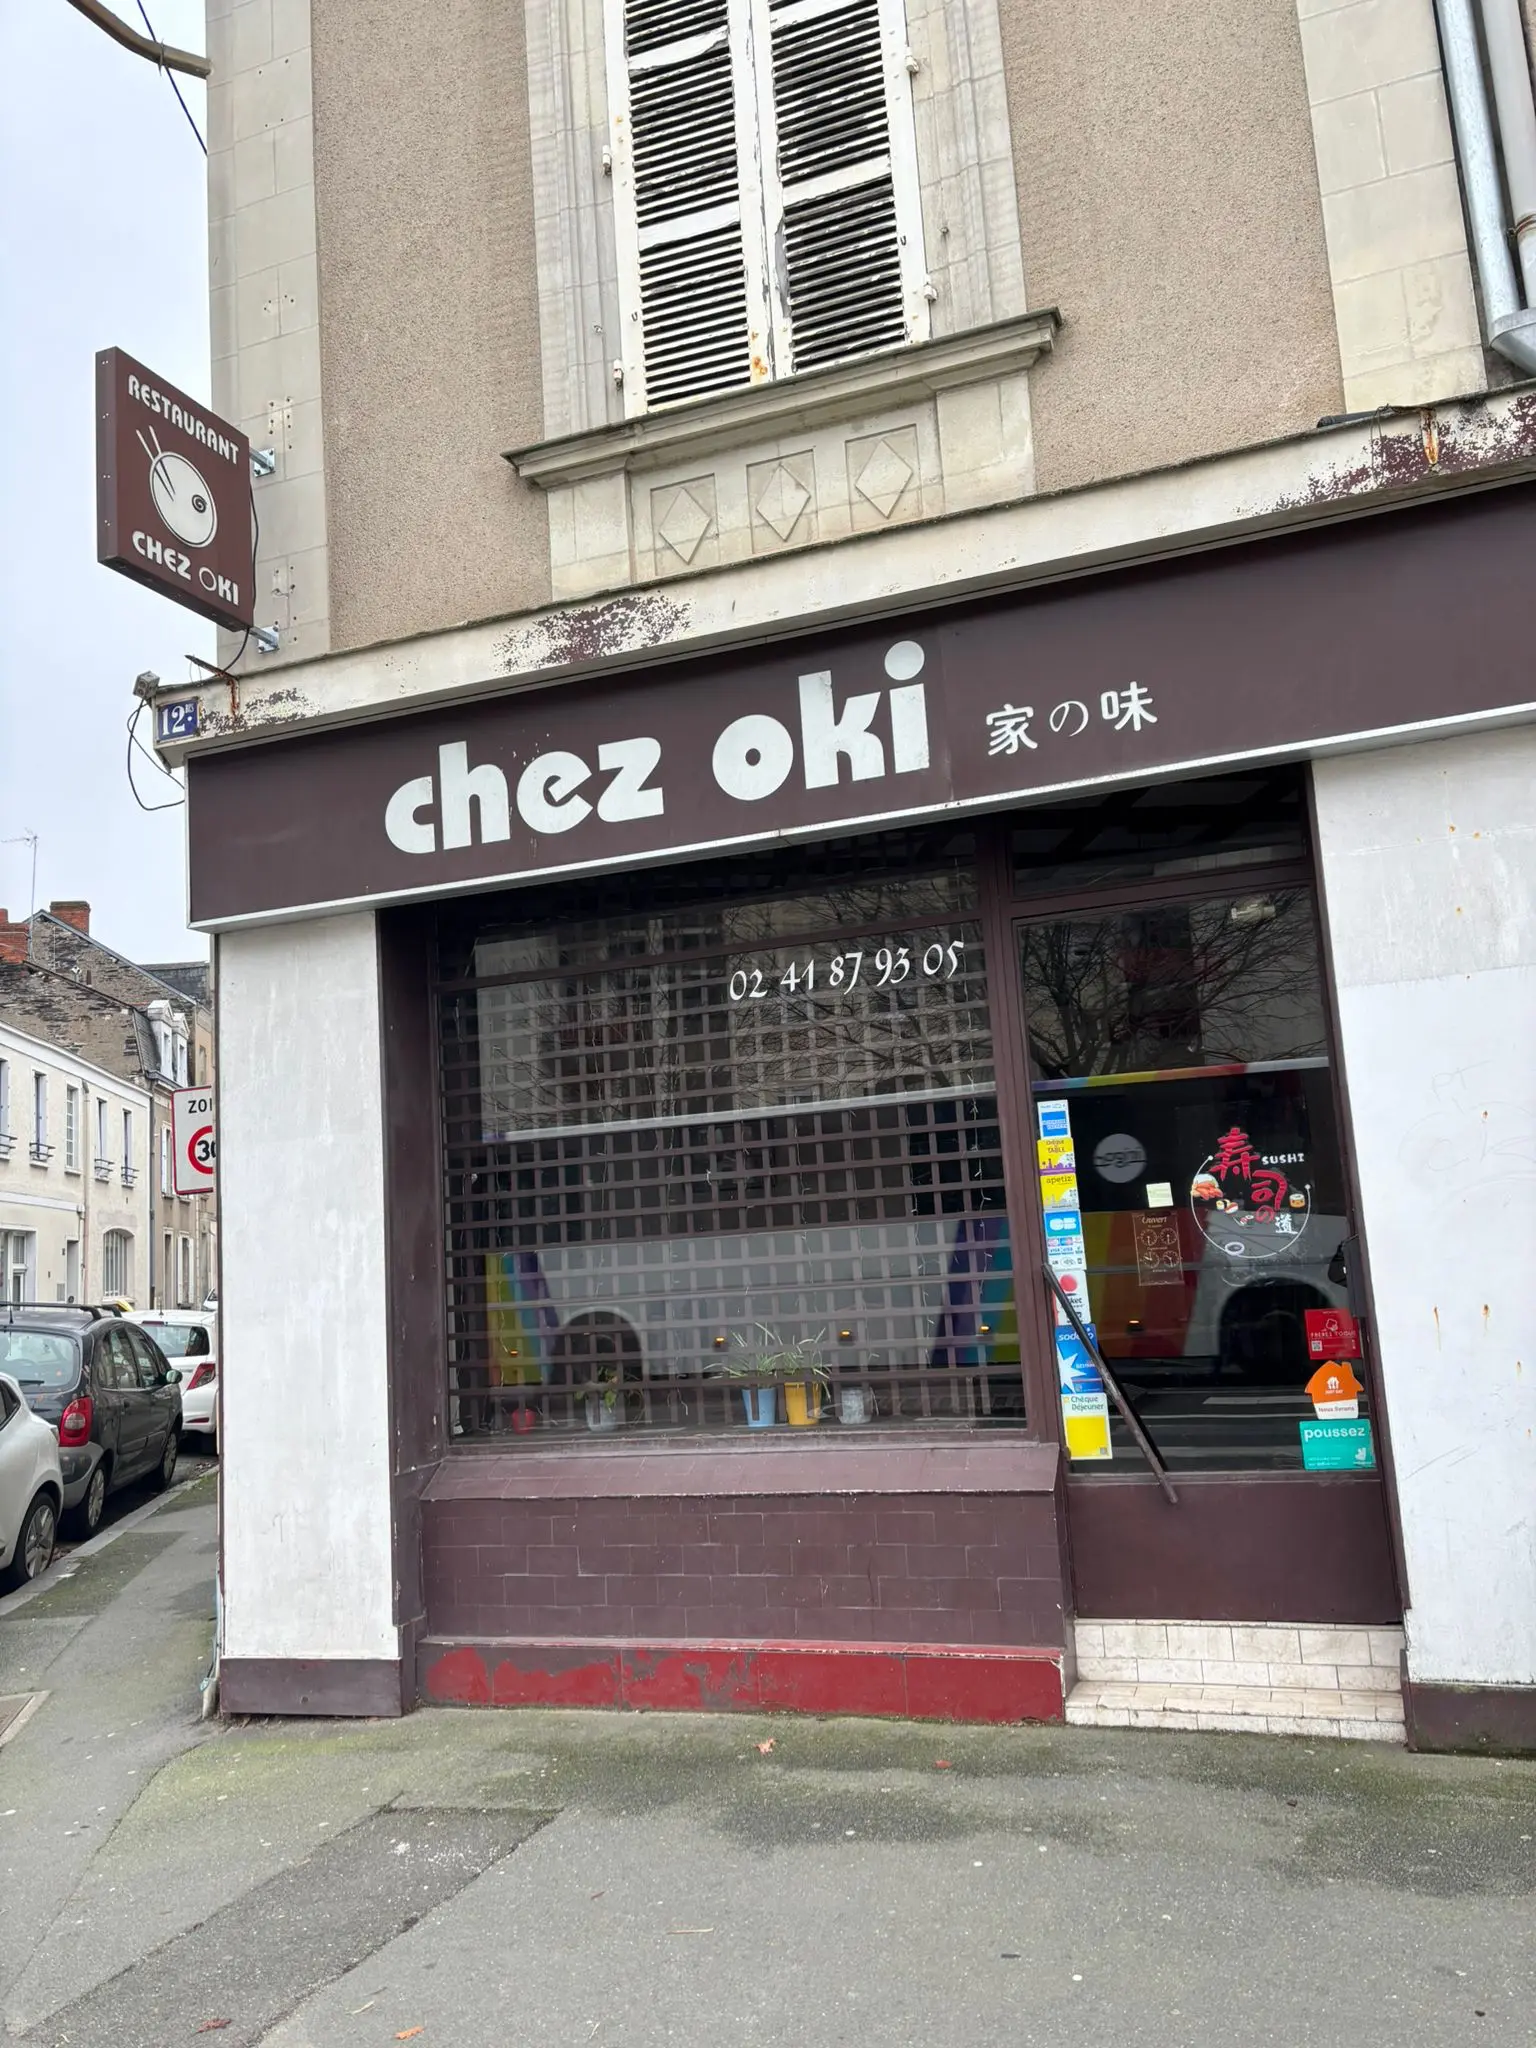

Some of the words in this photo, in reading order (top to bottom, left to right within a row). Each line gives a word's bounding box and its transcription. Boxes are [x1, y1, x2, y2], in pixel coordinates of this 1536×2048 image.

[128, 373, 240, 465] RESTAURANT
[132, 530, 192, 581] CHEZ
[199, 566, 240, 606] OKI
[162, 705, 186, 736] 12
[985, 680, 1158, 756] 家の味
[384, 736, 665, 854] chez
[711, 640, 931, 801] oki
[729, 968, 768, 1001] 02
[780, 959, 815, 993] 41
[829, 951, 863, 995] 87
[875, 947, 911, 986] 93
[922, 940, 964, 979] 05
[188, 1098, 213, 1114] ZO
[1261, 1152, 1305, 1166] SUSHI
[1046, 1175, 1073, 1186] apetiz
[1071, 1402, 1105, 1413] Déjeuner
[1304, 1427, 1366, 1443] poussez
